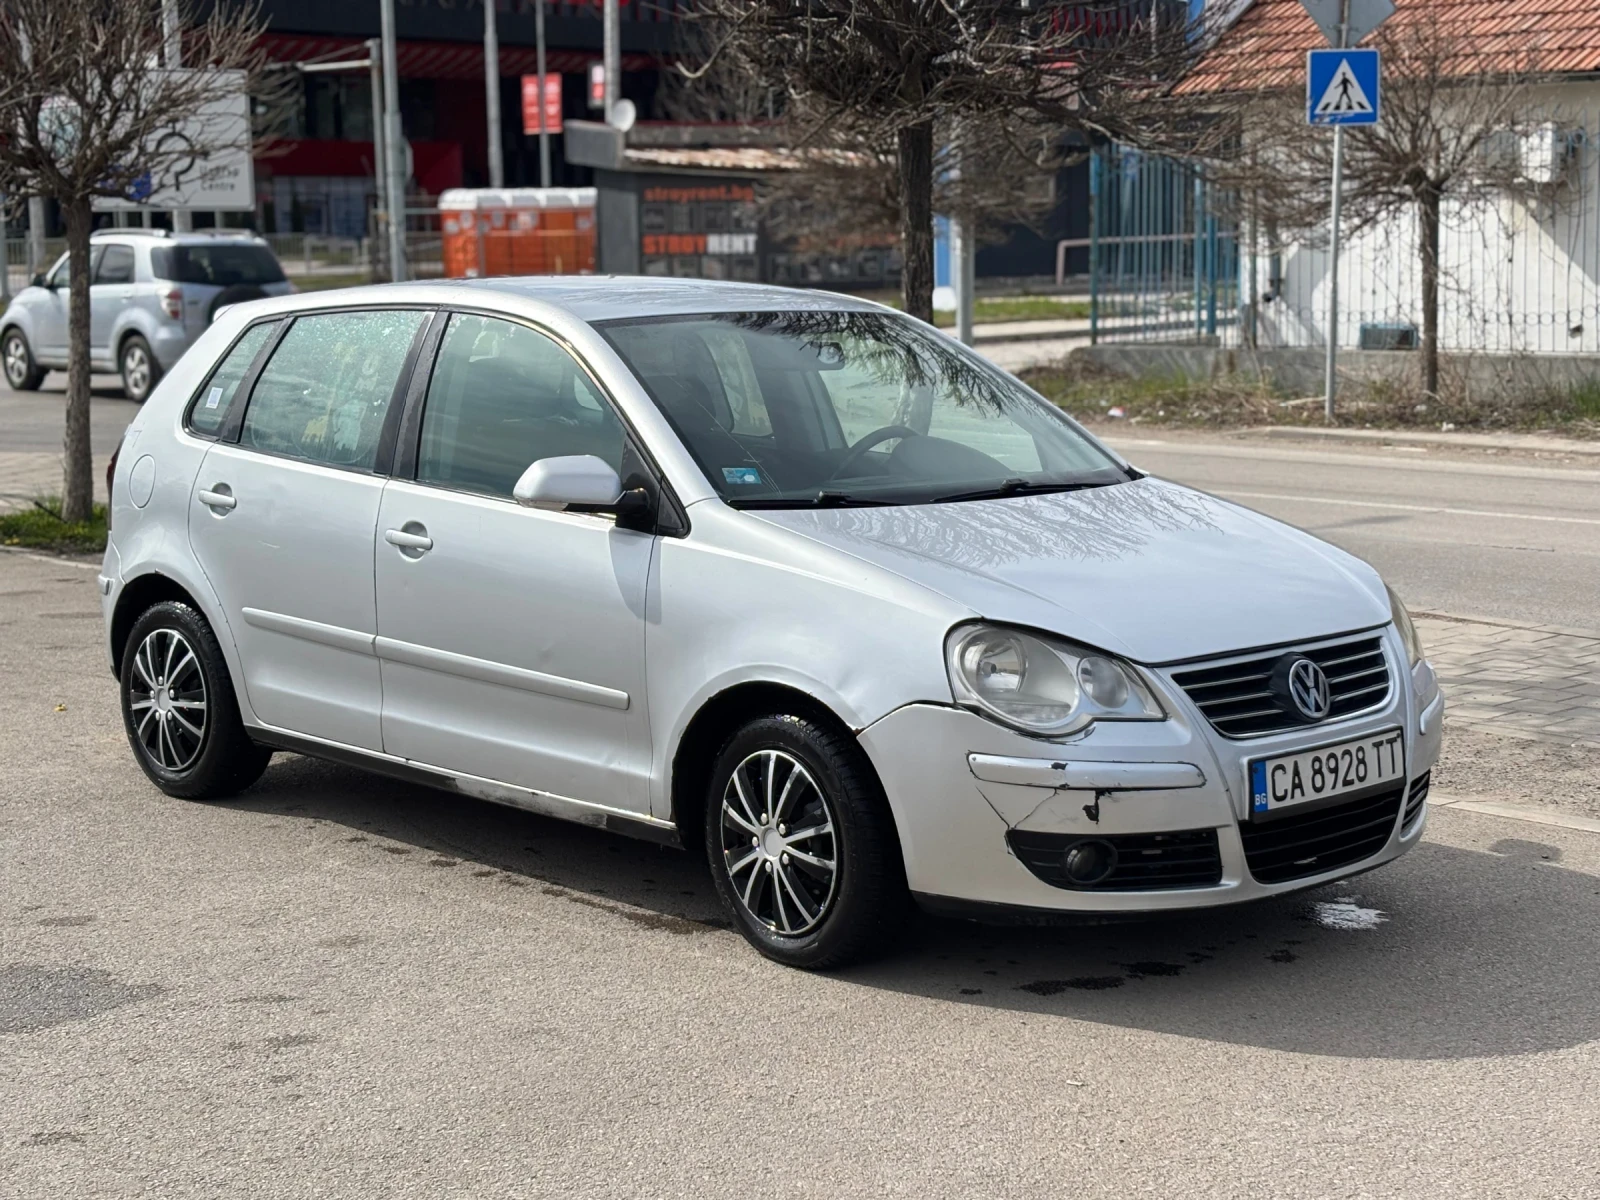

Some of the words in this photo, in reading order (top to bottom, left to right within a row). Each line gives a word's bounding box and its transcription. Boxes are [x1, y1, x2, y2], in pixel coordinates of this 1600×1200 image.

[1271, 760, 1305, 802] CA
[1311, 746, 1368, 794] 8928
[1371, 738, 1397, 778] TT
[1254, 793, 1267, 806] BG
